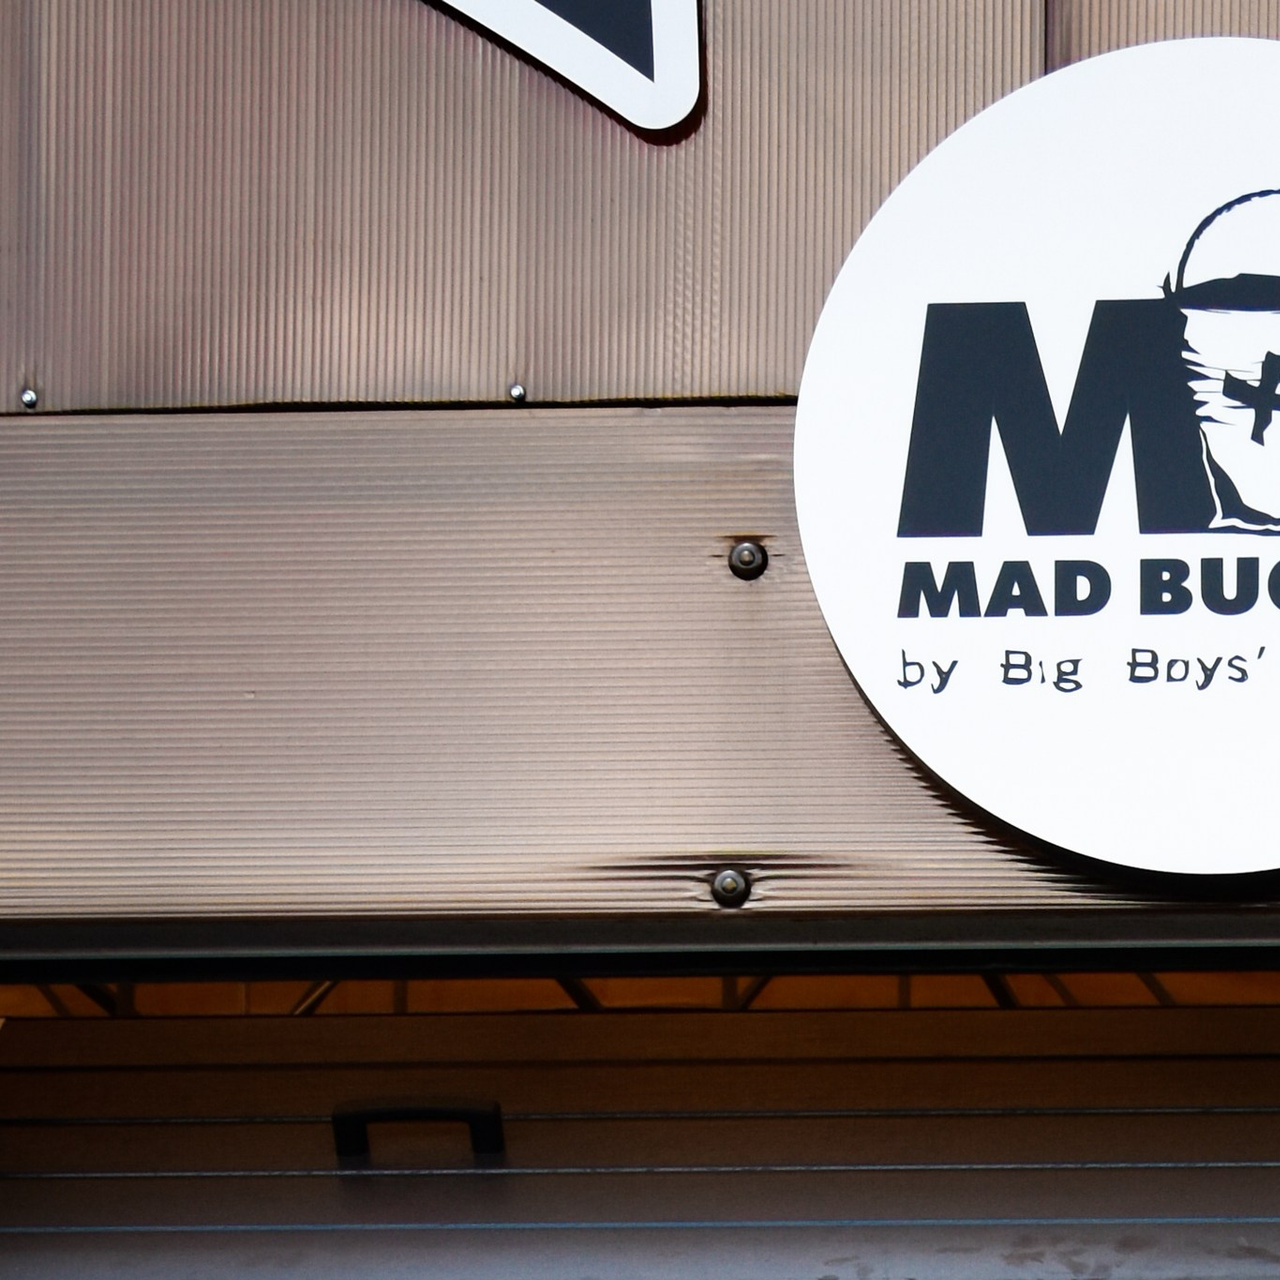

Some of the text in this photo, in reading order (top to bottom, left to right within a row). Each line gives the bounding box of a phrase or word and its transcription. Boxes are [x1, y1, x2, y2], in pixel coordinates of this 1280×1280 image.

[897, 559, 1111, 618] MAD
[897, 648, 959, 693] by
[1000, 650, 1083, 693] Big
[1126, 645, 1267, 691] Boys'
